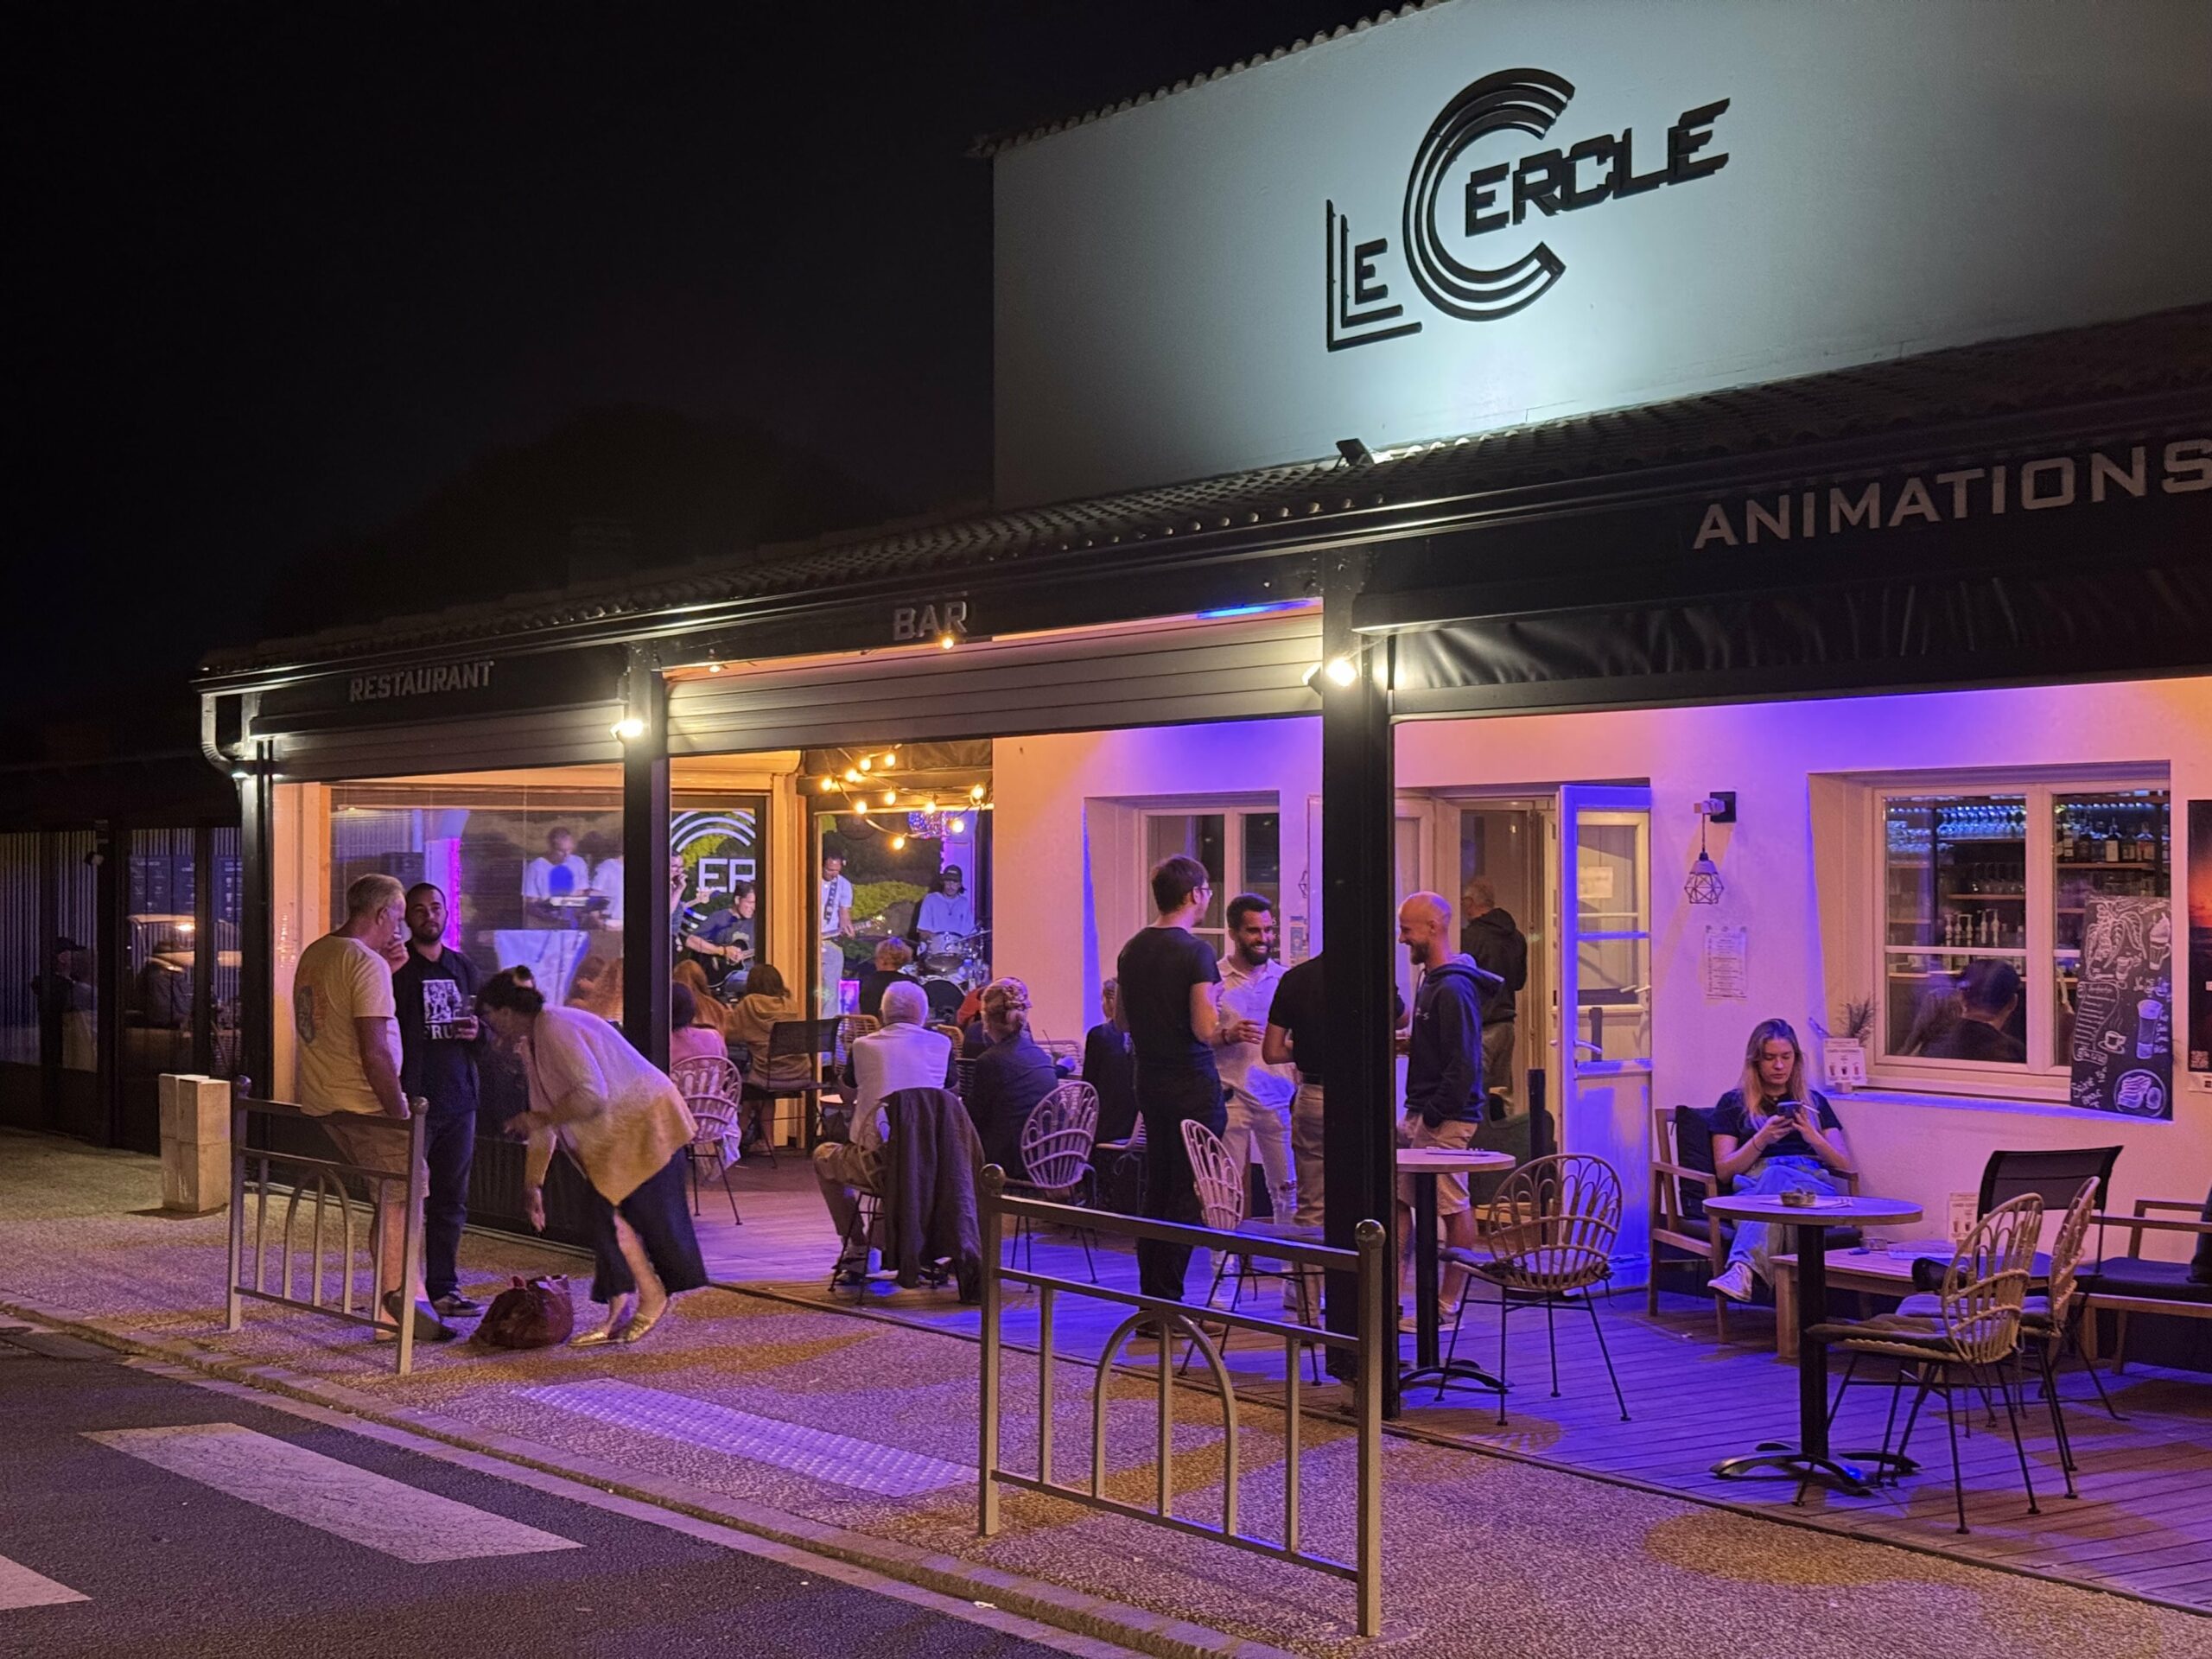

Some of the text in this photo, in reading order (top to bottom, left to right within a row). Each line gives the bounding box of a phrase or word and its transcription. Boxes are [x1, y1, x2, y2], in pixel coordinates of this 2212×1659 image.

[1326, 67, 1731, 353] LE CERCLE
[1692, 438, 2212, 550] ANIMATIONS
[893, 601, 968, 640] BAR
[349, 661, 494, 702] RESTAURANT
